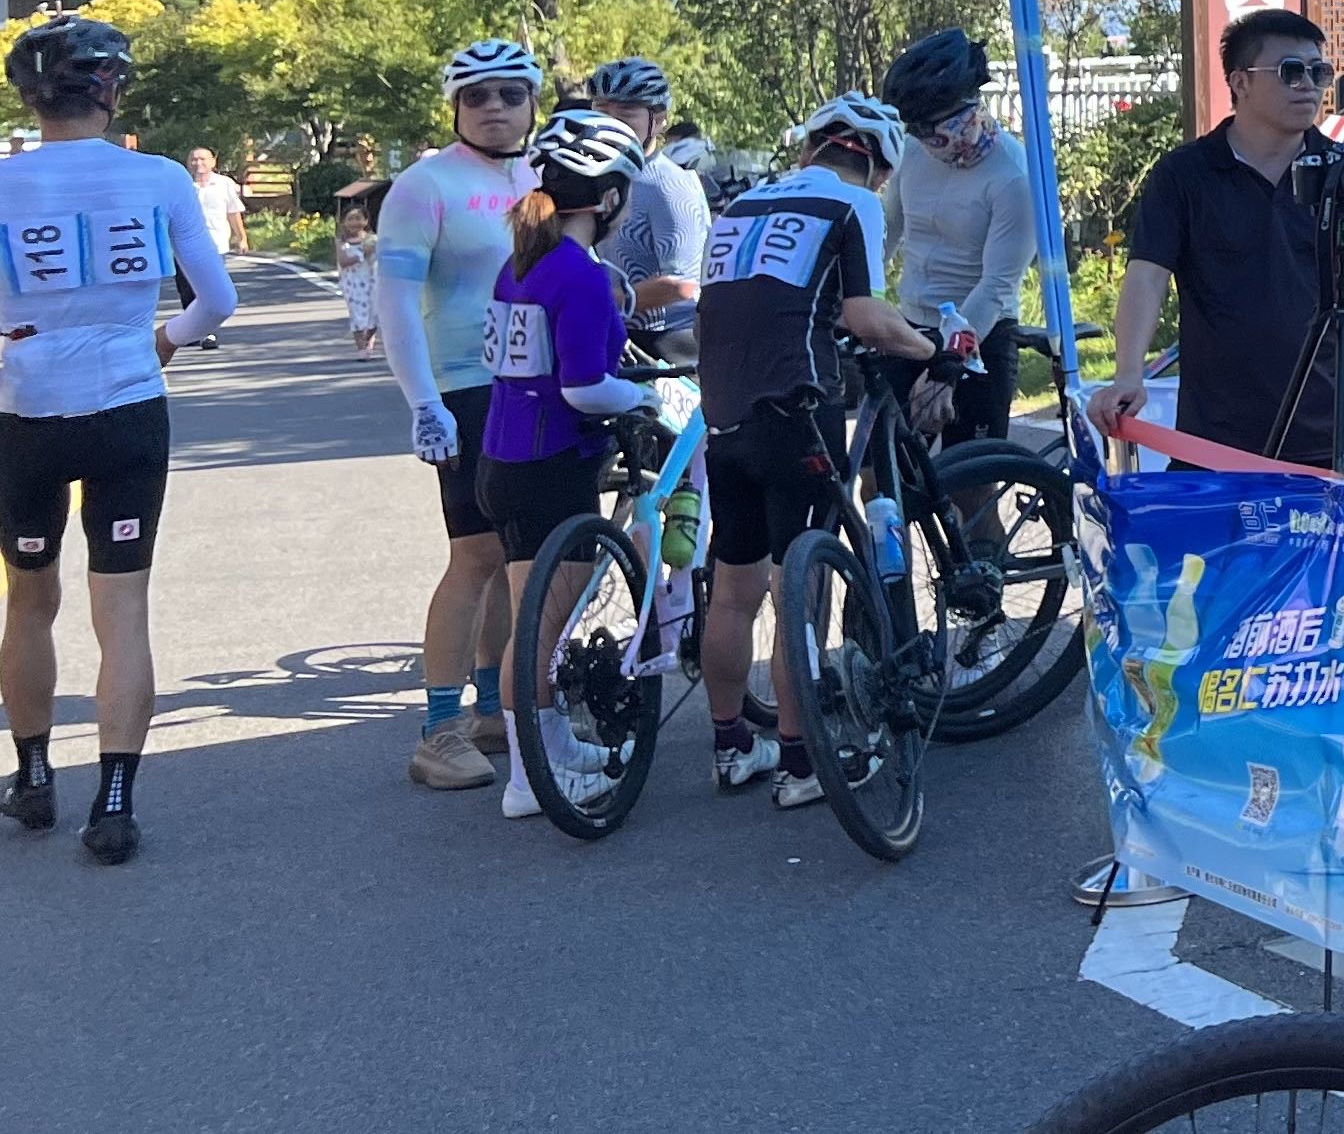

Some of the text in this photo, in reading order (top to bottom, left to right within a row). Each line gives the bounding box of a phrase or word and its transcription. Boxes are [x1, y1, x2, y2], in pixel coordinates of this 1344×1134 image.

[22, 223, 65, 284] 118
[108, 215, 150, 277] 118
[706, 226, 741, 280] 105
[759, 216, 806, 266] 105
[508, 308, 529, 367] 152
